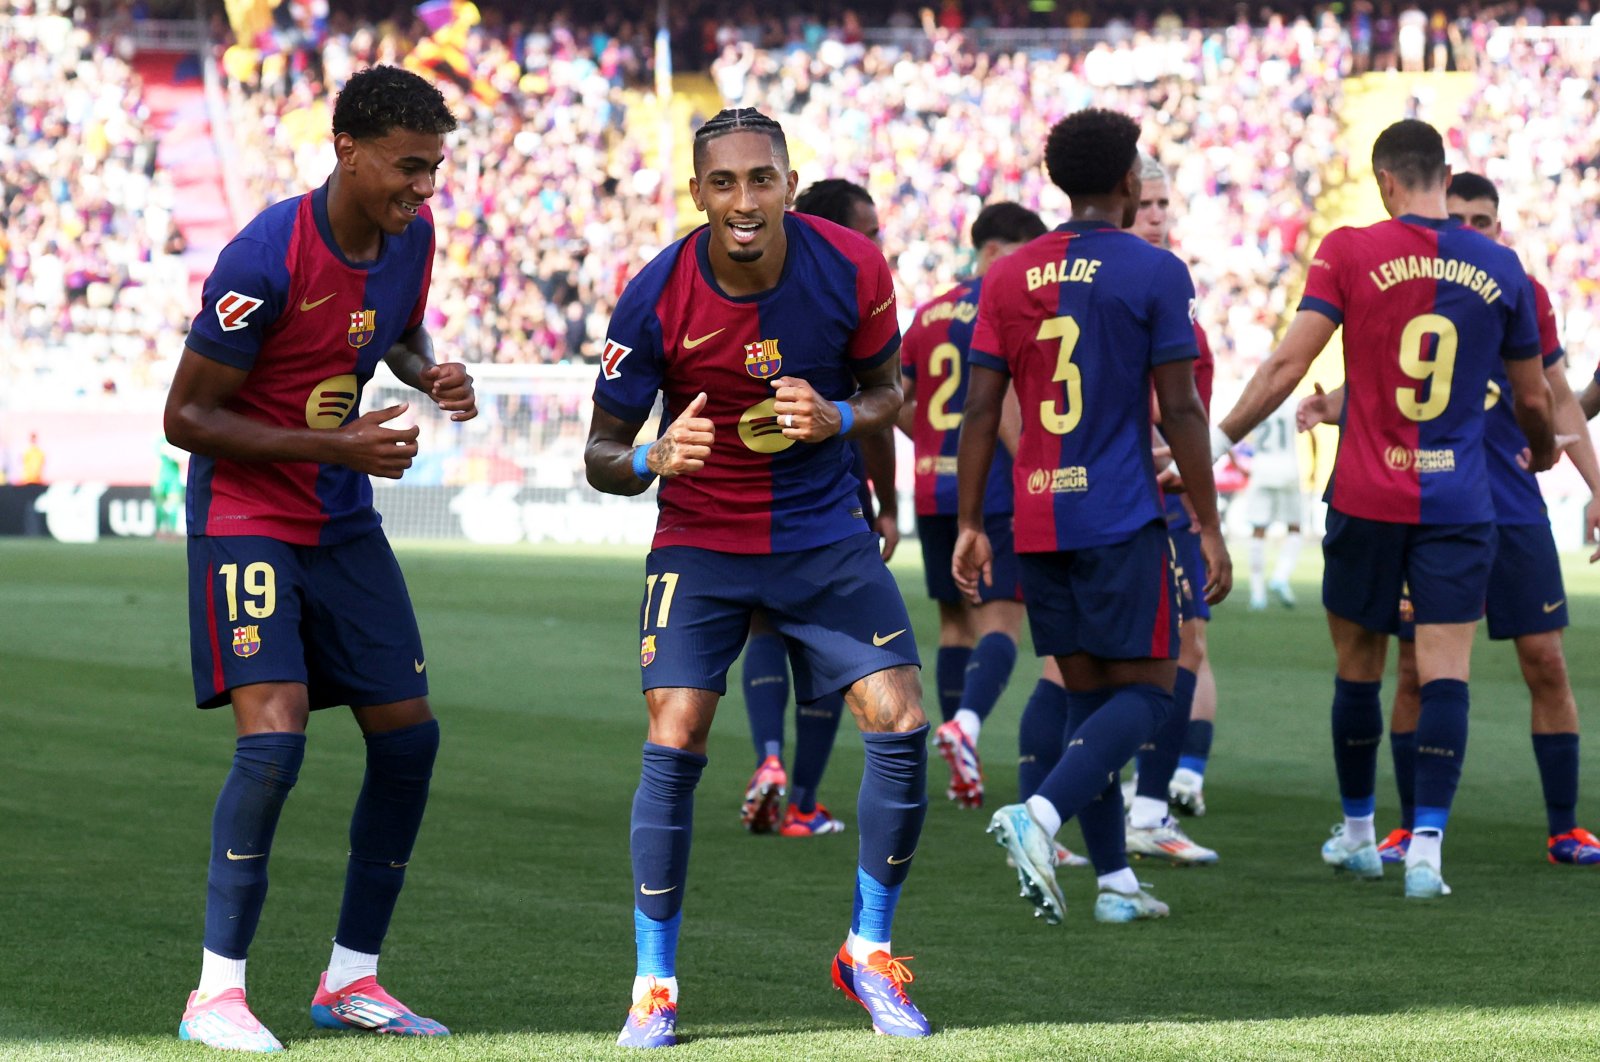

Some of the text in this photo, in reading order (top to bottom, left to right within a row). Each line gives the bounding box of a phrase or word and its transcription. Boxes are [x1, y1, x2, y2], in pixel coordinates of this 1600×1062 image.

[1026, 258, 1102, 291] BALDE
[1369, 255, 1502, 305] LEWANDOWSKI
[928, 342, 964, 431] 2
[1036, 315, 1083, 435] 3
[1396, 313, 1458, 422] 9
[1256, 418, 1287, 452] 21
[218, 561, 276, 621] 19
[643, 572, 679, 630] 11
[332, 999, 369, 1015] F50
